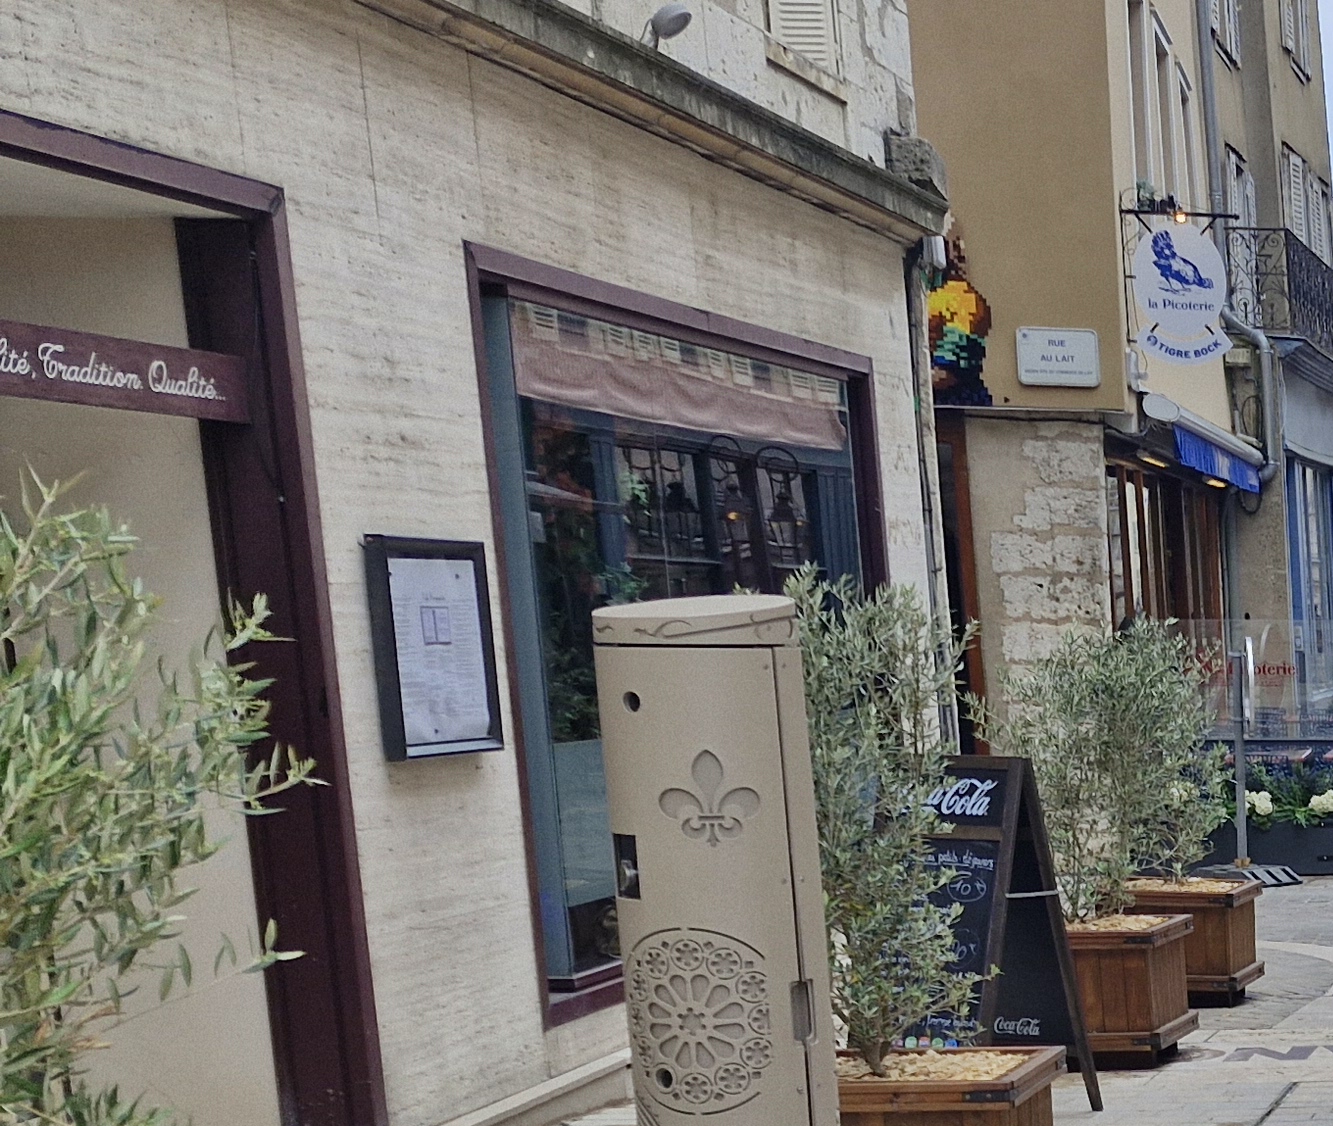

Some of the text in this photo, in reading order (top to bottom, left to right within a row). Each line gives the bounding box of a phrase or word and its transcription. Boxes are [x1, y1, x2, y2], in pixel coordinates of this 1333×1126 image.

[1148, 298, 1215, 312] la Picoterie
[1048, 339, 1066, 347] RUE
[1158, 339, 1222, 359] TIGRE BOCK
[1040, 354, 1075, 363] AU LAIT
